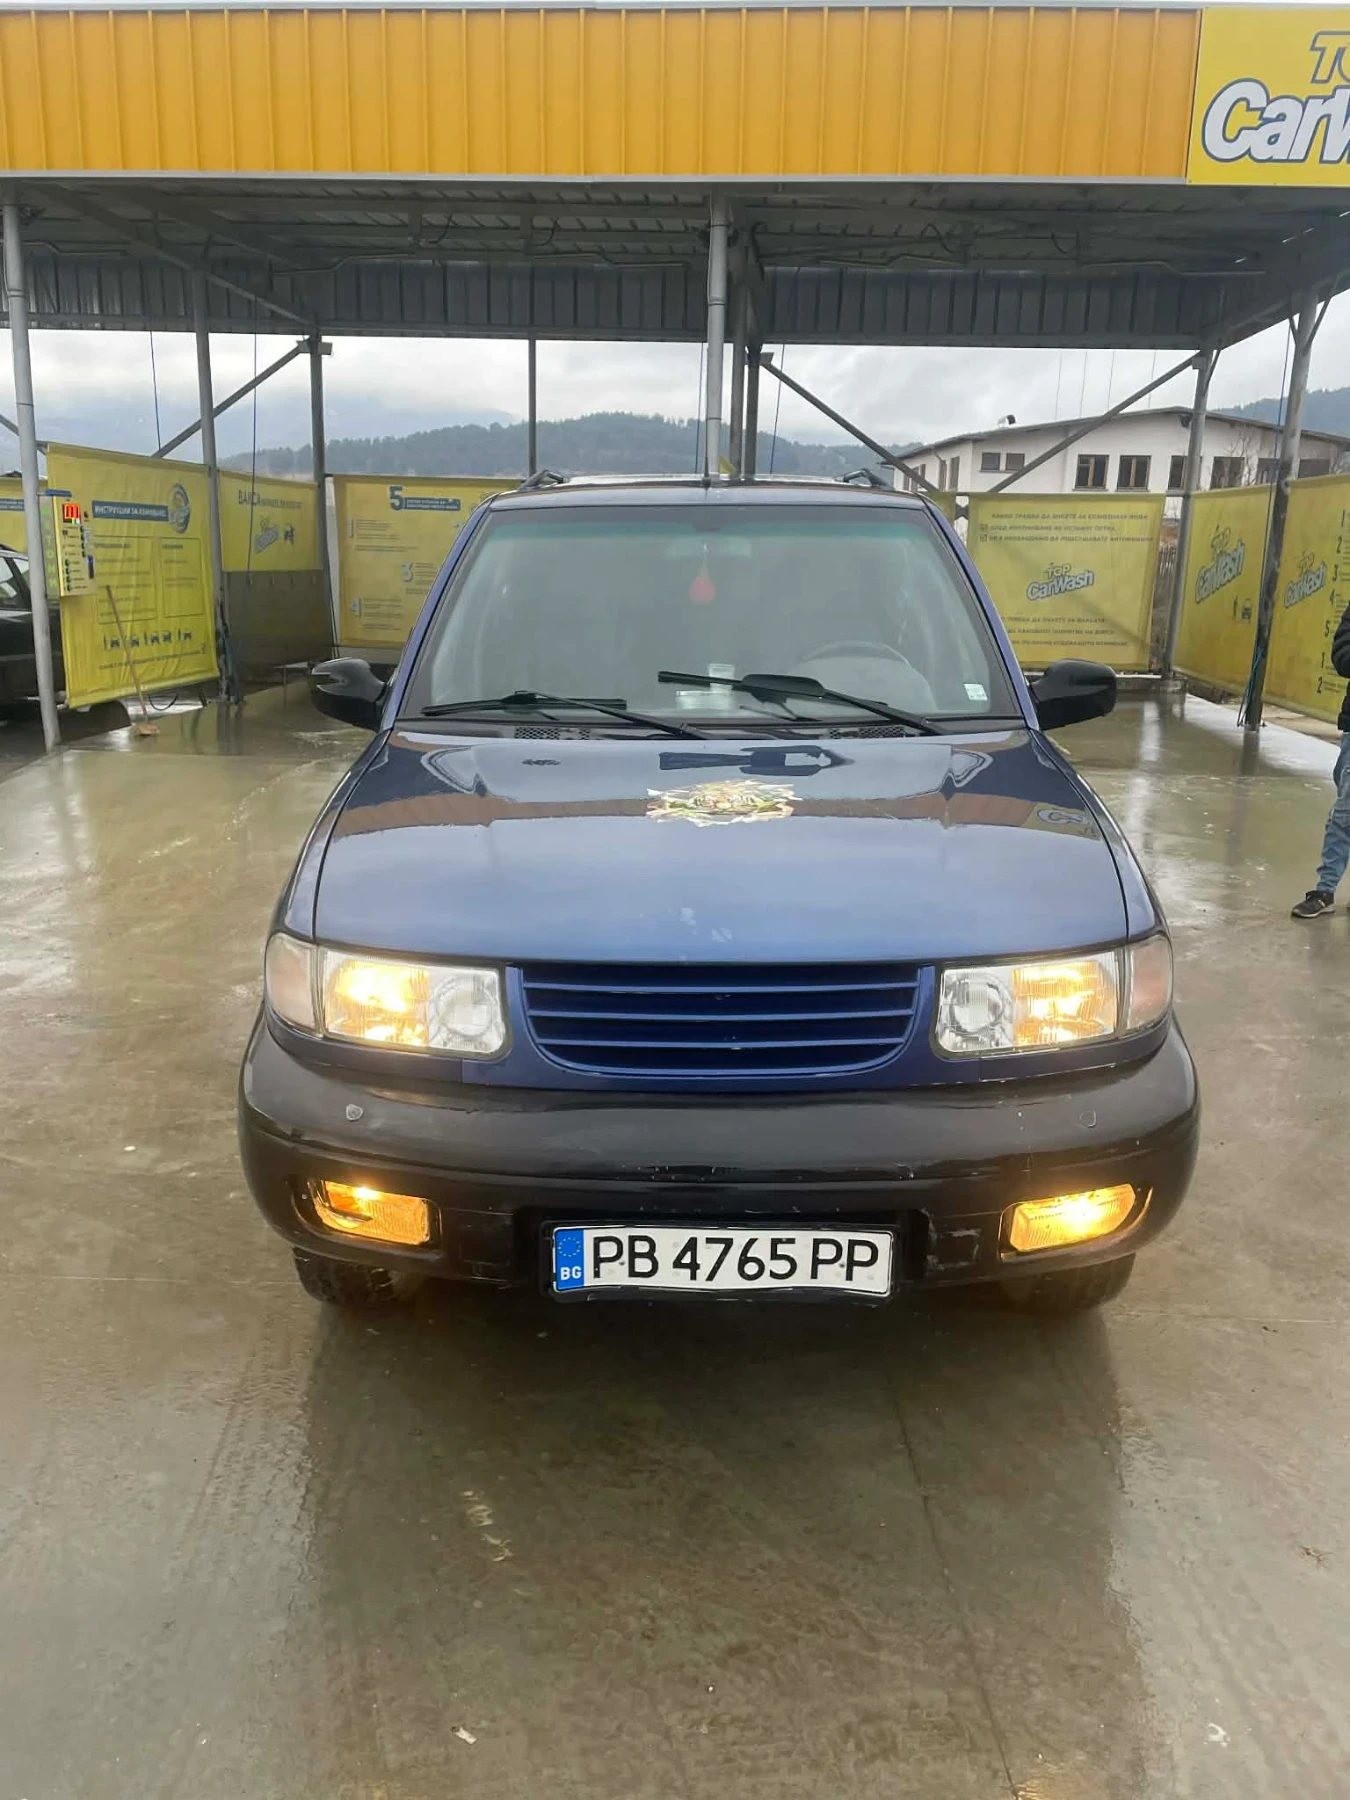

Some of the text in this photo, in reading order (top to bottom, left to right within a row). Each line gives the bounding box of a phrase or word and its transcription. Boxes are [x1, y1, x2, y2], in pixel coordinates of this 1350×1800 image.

[389, 486, 404, 511] 5
[1026, 569, 1094, 601] CarWash
[1045, 564, 1072, 580] TOP
[1195, 539, 1245, 604] CarWash
[592, 1234, 879, 1283] PB 4765 PP
[560, 1266, 583, 1282] BG
